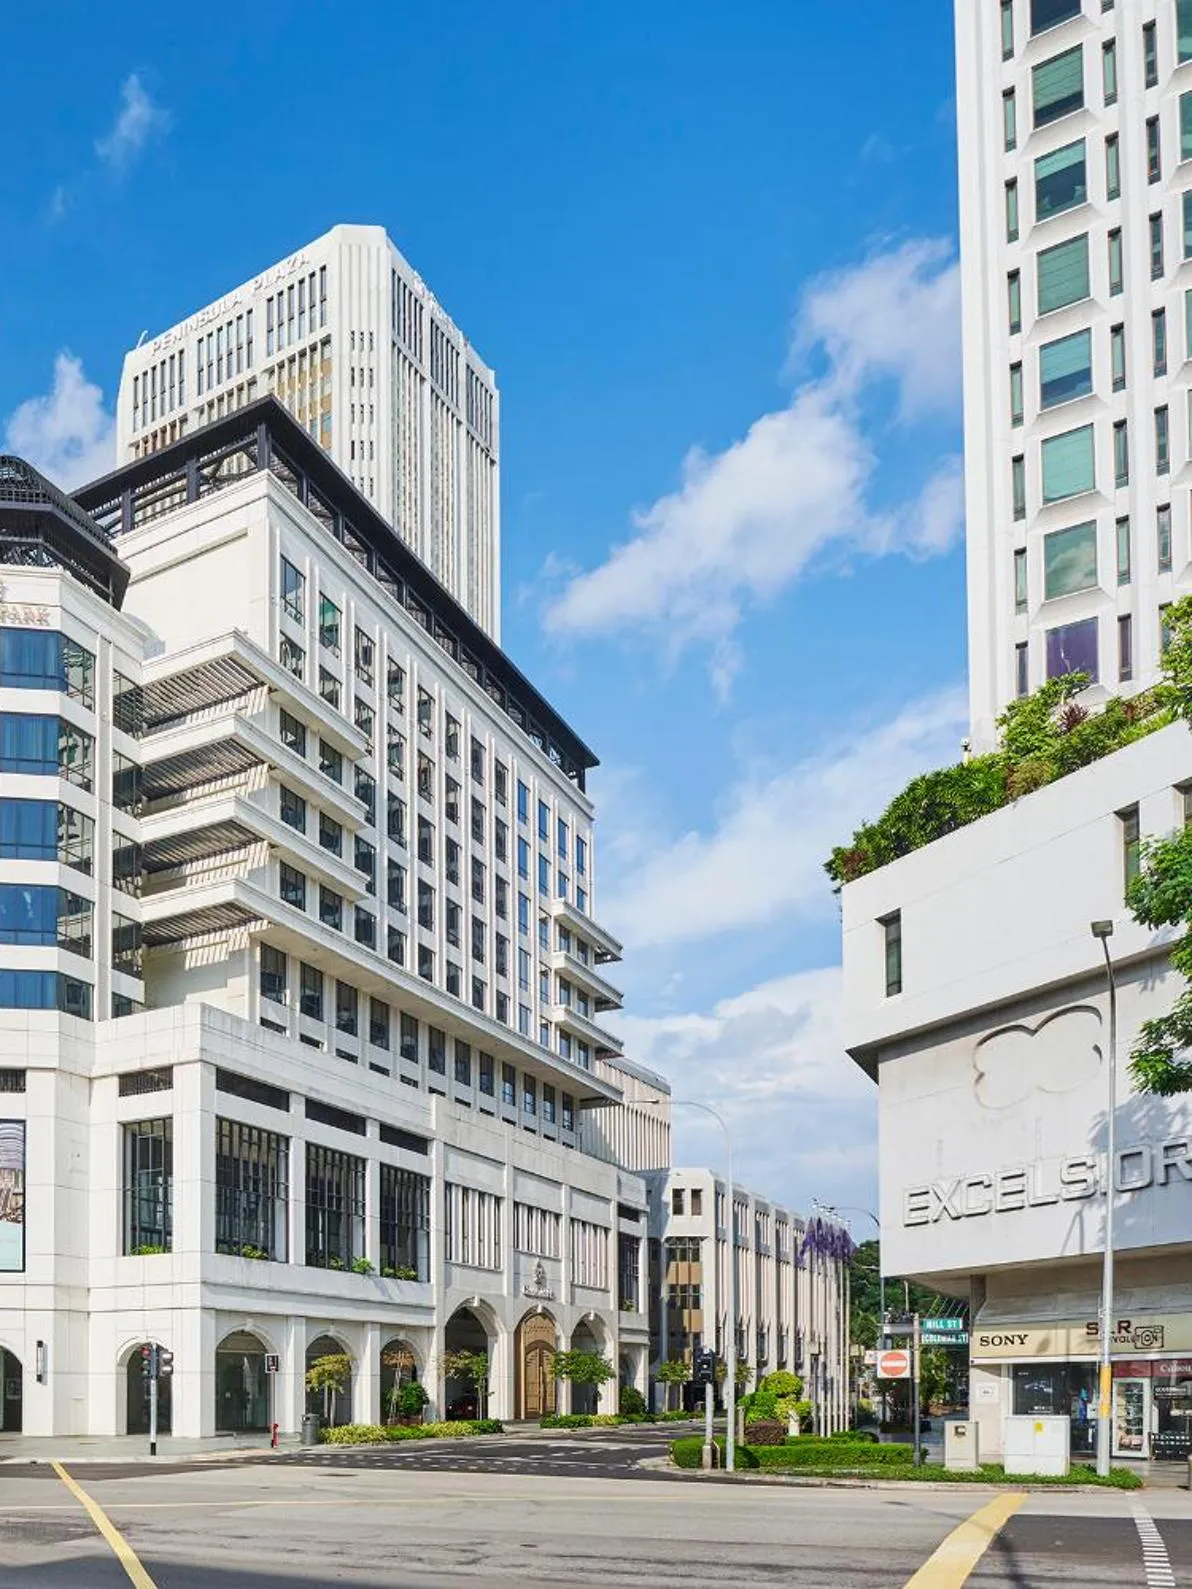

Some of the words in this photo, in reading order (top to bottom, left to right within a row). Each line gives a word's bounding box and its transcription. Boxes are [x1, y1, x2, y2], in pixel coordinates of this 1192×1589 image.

[253, 251, 309, 295] PLAZA
[0, 604, 50, 626] PARK
[903, 1137, 1192, 1228] EXCELSIOR
[1086, 1320, 1132, 1336] SR
[979, 1334, 1028, 1347] SONY
